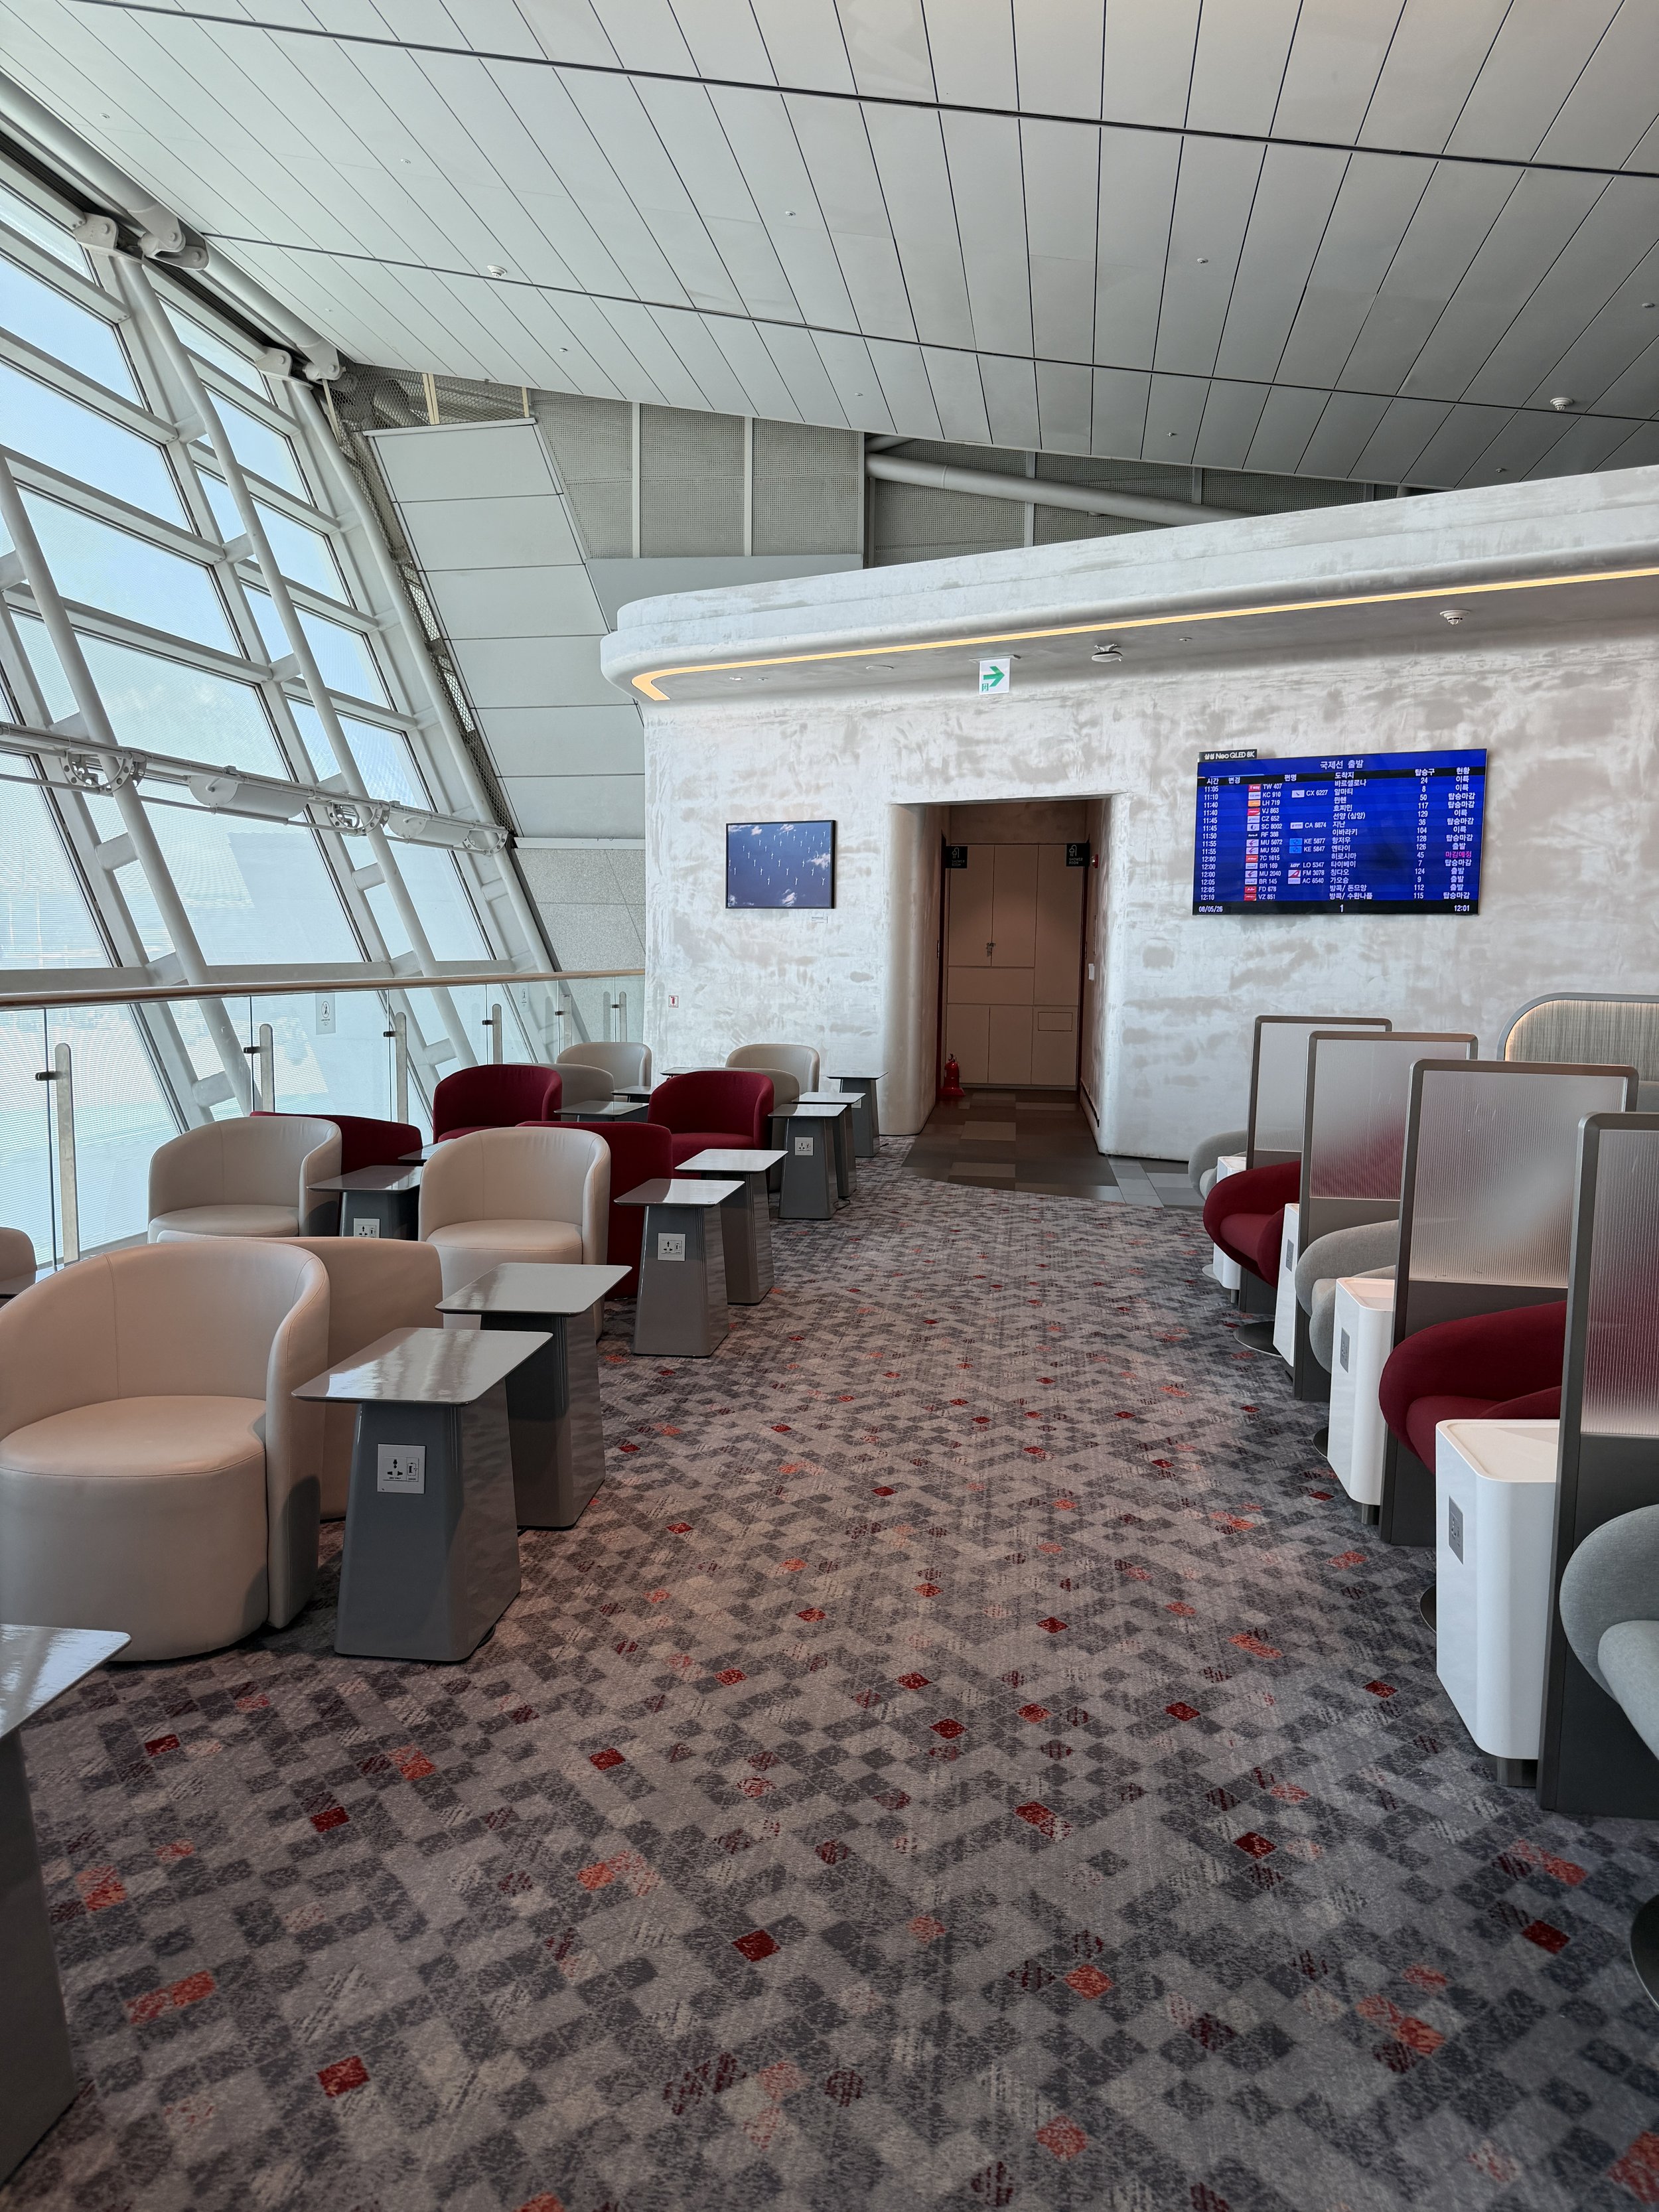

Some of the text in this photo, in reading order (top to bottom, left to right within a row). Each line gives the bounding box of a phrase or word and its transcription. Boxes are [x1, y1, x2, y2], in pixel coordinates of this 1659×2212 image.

[1320, 759, 1364, 770] 국제선 출발
[1448, 800, 1475, 808] 탑승마감
